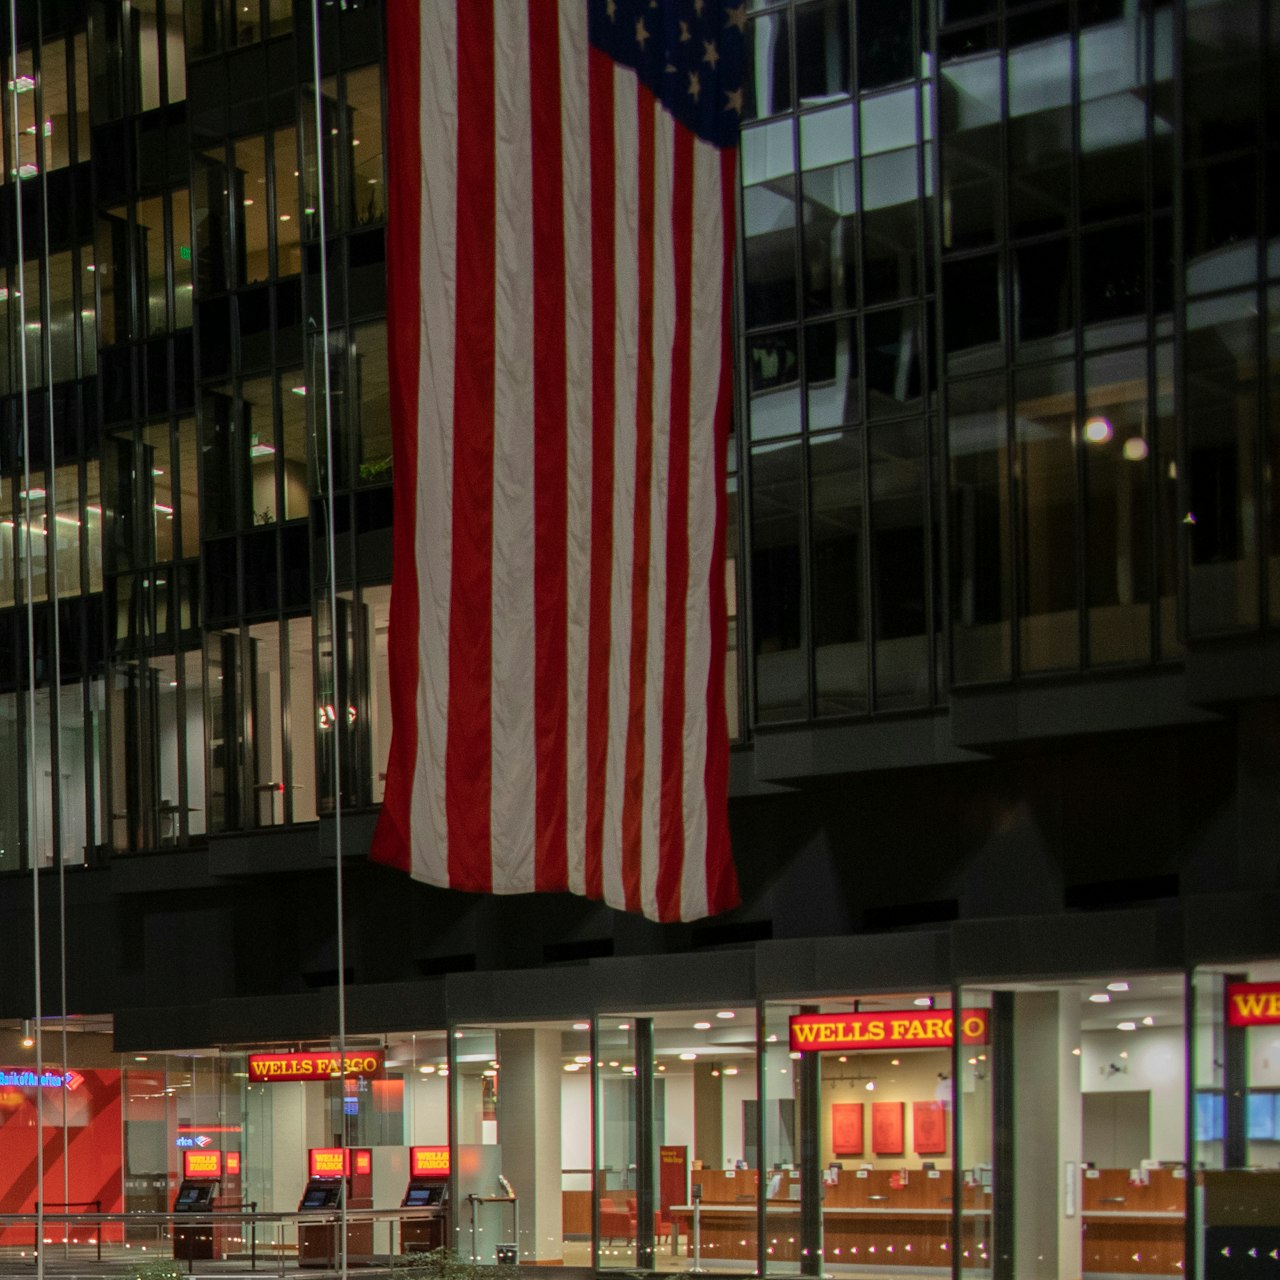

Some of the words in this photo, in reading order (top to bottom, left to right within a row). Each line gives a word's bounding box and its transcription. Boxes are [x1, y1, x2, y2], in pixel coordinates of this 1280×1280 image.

[793, 1021, 885, 1042] WELLS
[252, 1059, 313, 1076] WELLS
[316, 1057, 377, 1074] FARGO
[188, 1155, 218, 1164] WELLS
[416, 1151, 449, 1161] WELLS
[189, 1163, 218, 1172] FARGO
[417, 1160, 449, 1169] FARGO
